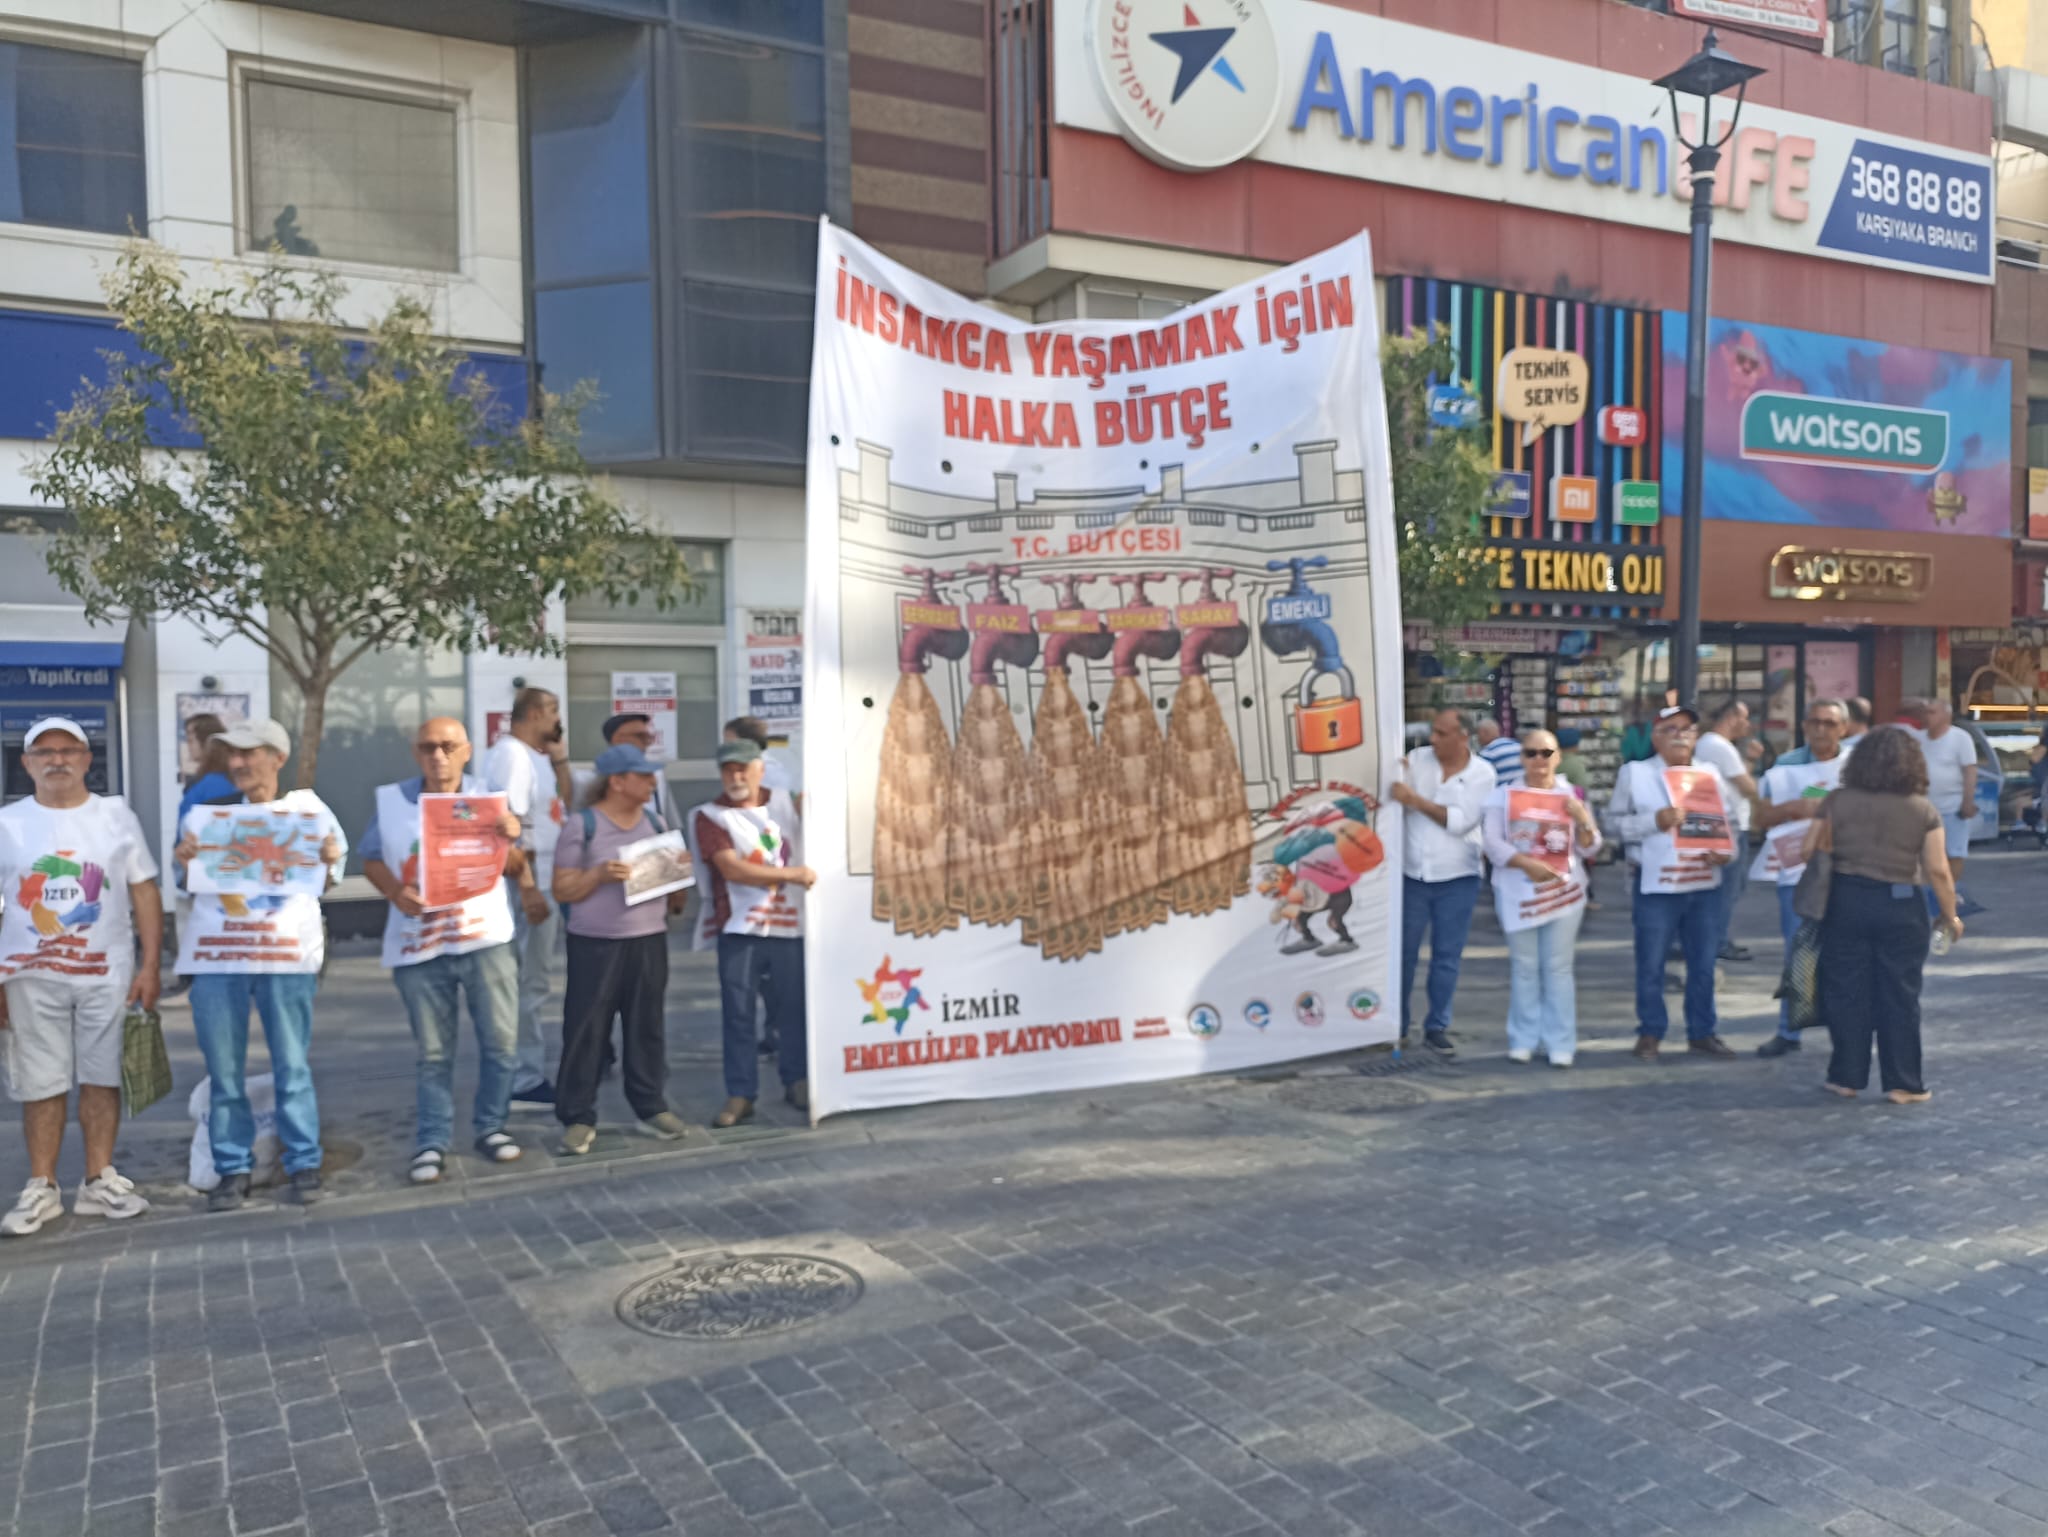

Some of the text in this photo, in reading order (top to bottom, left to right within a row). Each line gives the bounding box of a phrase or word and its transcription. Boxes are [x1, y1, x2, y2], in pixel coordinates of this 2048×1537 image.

[1291, 31, 1668, 196] American
[1850, 155, 1982, 222] 368 88 88
[1856, 210, 1979, 253] KARŞIYAKA BRANCH
[836, 256, 1355, 389] İNSANCA YAŞAMAK İÇİN
[1514, 356, 1571, 380] TEKNİK
[942, 380, 1232, 450] HALKA BÜTÇE
[1523, 385, 1580, 408] SERVİS
[1769, 409, 1923, 458] watsons
[1793, 555, 1915, 586] watsons
[942, 988, 1021, 1023] İZMİR
[843, 1016, 1123, 1074] EMEKLİLER PLATFORMU
